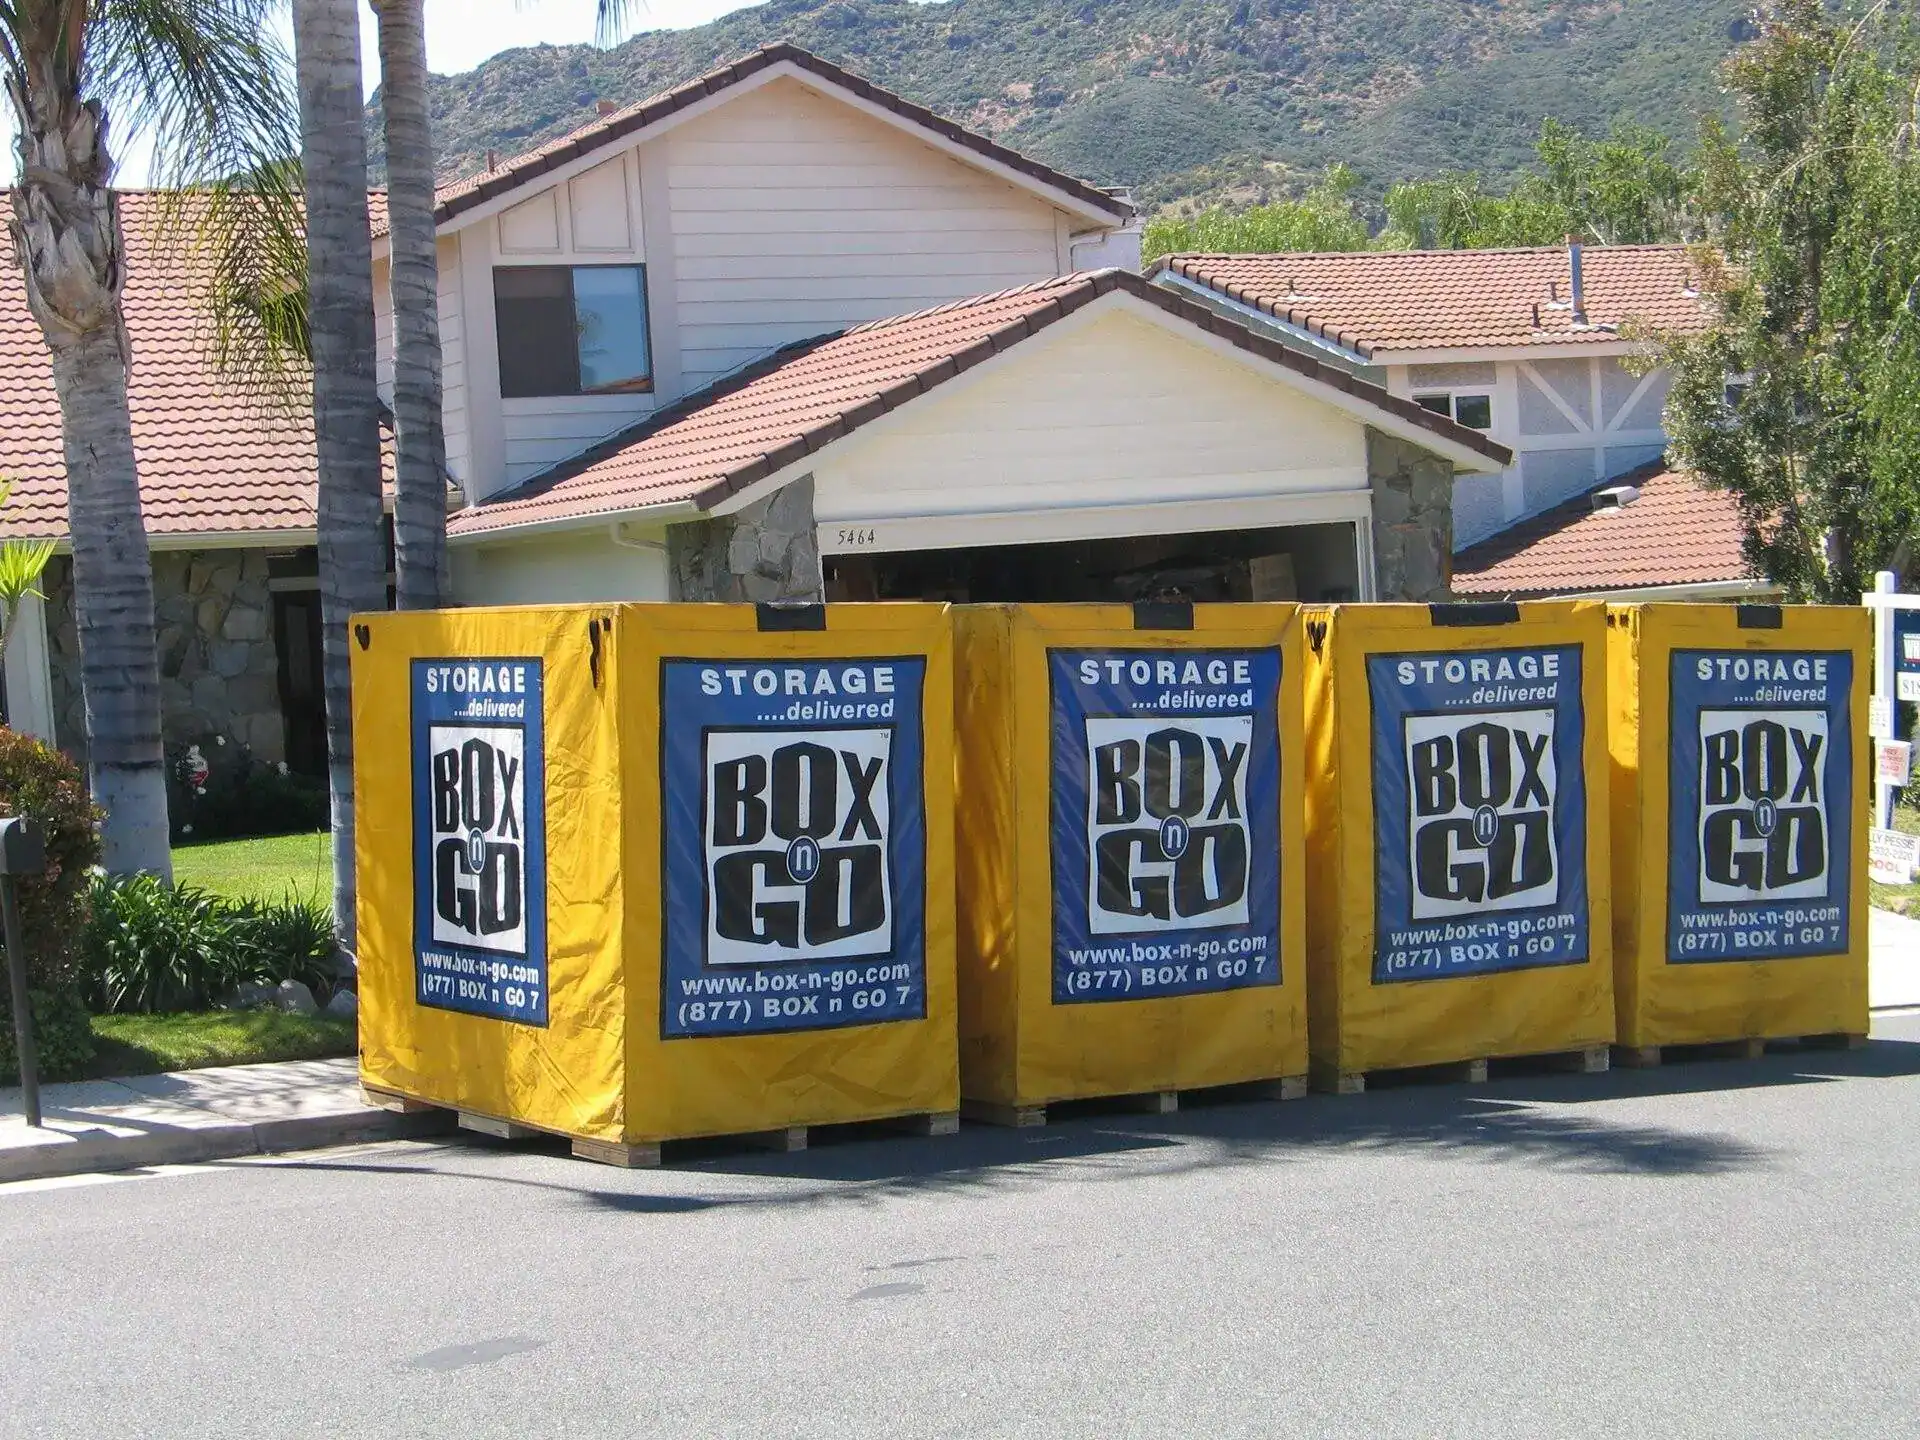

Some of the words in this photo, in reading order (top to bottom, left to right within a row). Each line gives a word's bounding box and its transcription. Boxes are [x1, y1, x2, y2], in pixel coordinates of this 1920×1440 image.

[838, 529, 875, 545] 5464
[427, 667, 526, 693] STORAGE
[701, 667, 895, 695] STORAGE
[1080, 660, 1251, 685] STORAGE
[1397, 654, 1558, 685] STORAGE
[1697, 658, 1827, 682] STORAGE
[1095, 727, 1247, 825] BOX
[1412, 722, 1550, 817] BOX
[1705, 719, 1823, 805] BOX
[434, 736, 519, 839] BOX
[713, 741, 883, 846] BOX
[1479, 814, 1492, 836] n
[1759, 805, 1771, 827] n
[472, 835, 481, 862] n
[1168, 825, 1182, 848] n
[1704, 806, 1824, 891] GO
[796, 847, 811, 871] n
[1096, 822, 1247, 921] GO
[1416, 810, 1552, 903] GO
[436, 837, 521, 936] GO
[713, 844, 886, 949] GO
[1391, 912, 1574, 946] www.box-n-go.com
[1680, 907, 1839, 928] www.box-n-go.com
[1069, 935, 1267, 965] www.box-n-go.com
[1386, 949, 1441, 973] (877)
[1451, 943, 1498, 963] BOX
[1508, 943, 1518, 957] n
[1526, 935, 1554, 954] GO
[1564, 933, 1576, 951] 7
[1678, 932, 1726, 953] (877)
[1734, 930, 1777, 947] BOX
[1784, 932, 1794, 945] n
[1801, 927, 1824, 943] GO
[1831, 926, 1839, 941] 7
[422, 952, 539, 984] www.box-n-go.com
[681, 961, 910, 995] www.box-n-go.com
[1066, 969, 1131, 994] (877)
[1141, 963, 1187, 986] BOX
[1196, 966, 1208, 981] n
[1217, 958, 1248, 979] GO
[1254, 956, 1265, 974] 7
[422, 974, 456, 997] (877)
[459, 981, 488, 1002] BOX
[492, 986, 499, 1003] n
[505, 985, 525, 1006] GO
[531, 990, 539, 1011] 7
[678, 1000, 752, 1024] (877)
[764, 996, 818, 1018] BOX
[829, 996, 842, 1012] n
[852, 988, 886, 1008] GO
[897, 986, 910, 1004] 7
